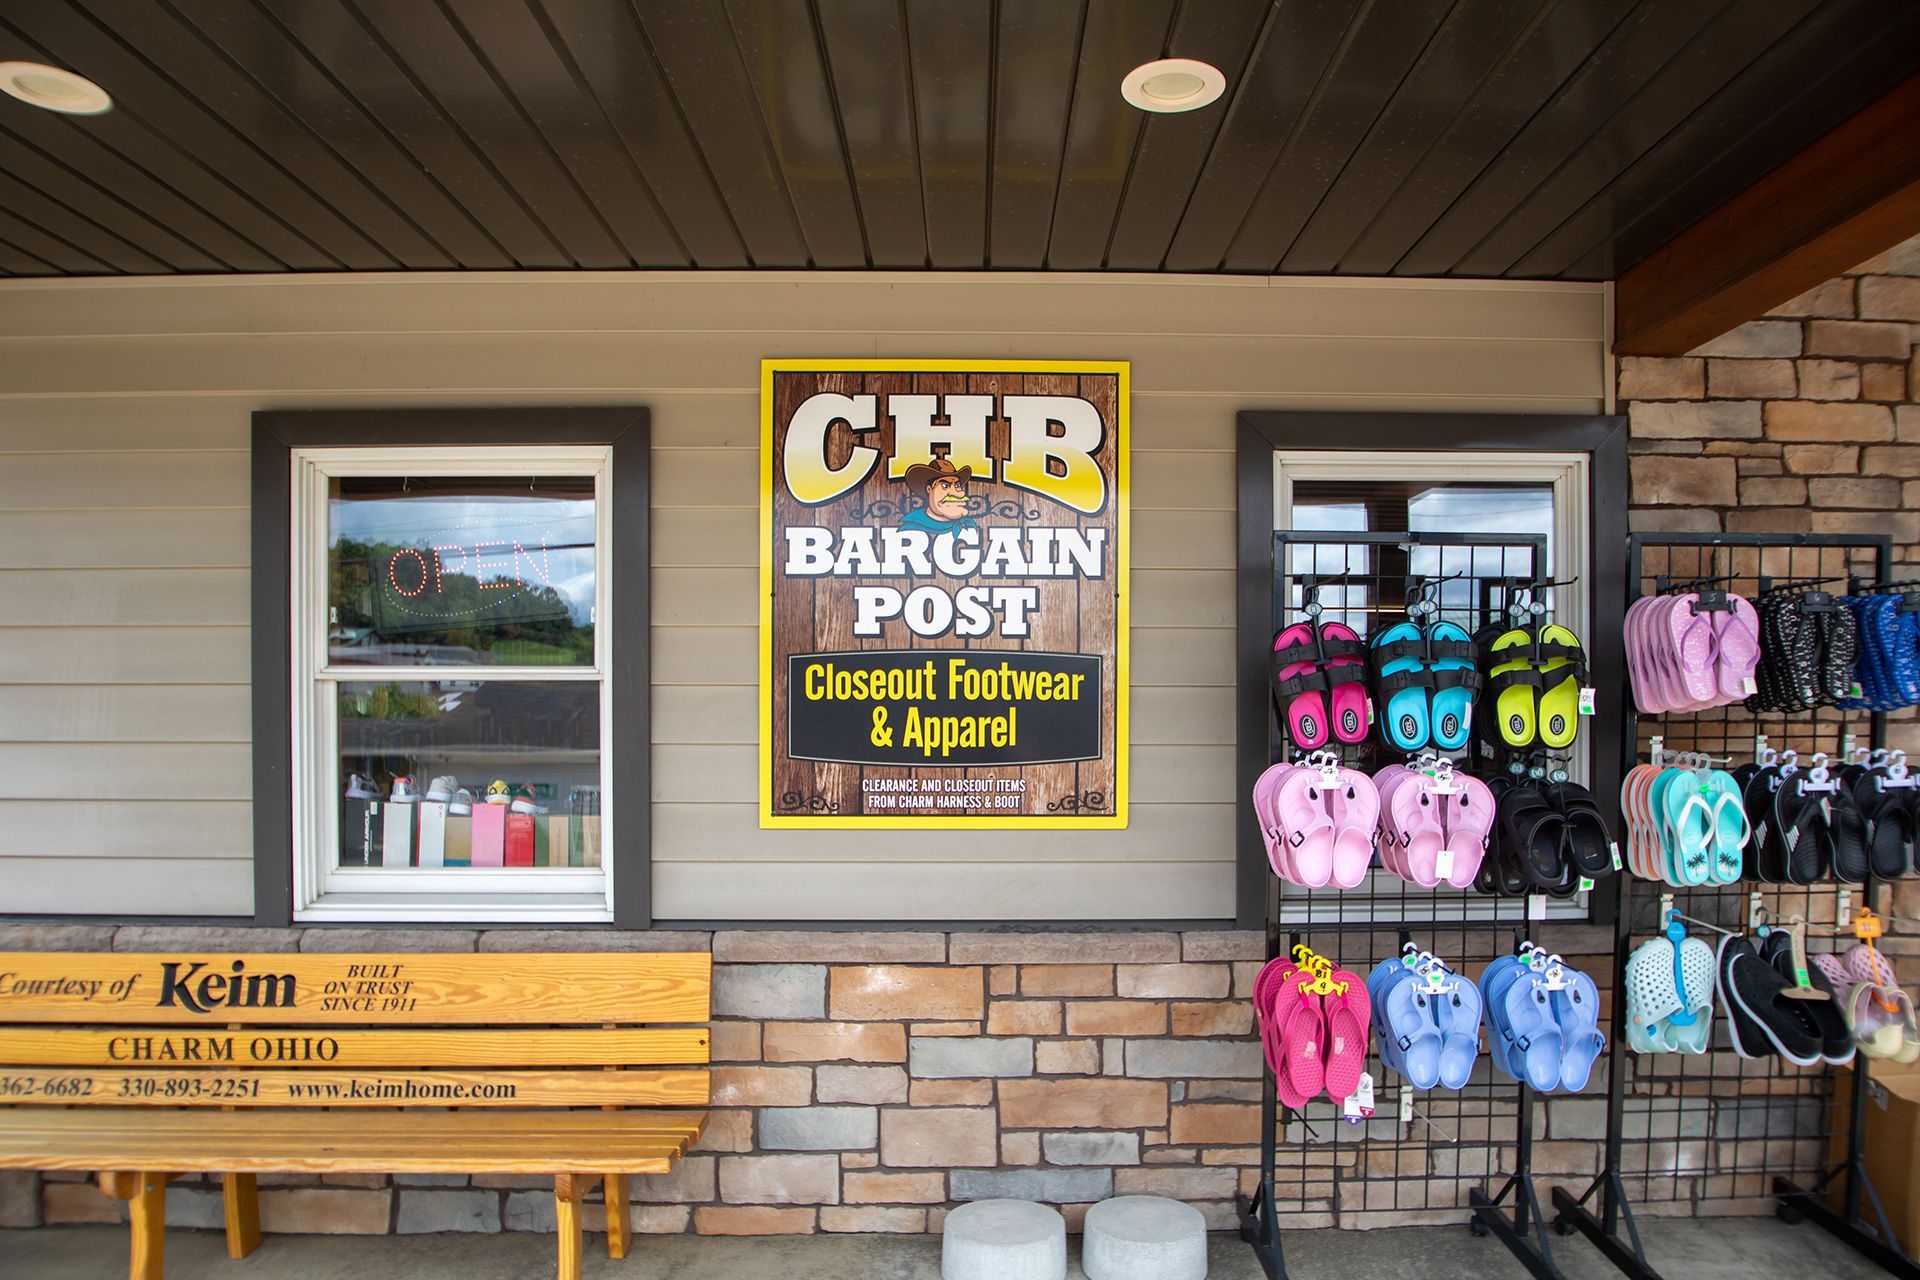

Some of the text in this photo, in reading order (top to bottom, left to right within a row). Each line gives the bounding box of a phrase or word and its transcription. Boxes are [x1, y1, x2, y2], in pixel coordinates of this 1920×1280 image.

[783, 392, 1106, 514] CHB
[390, 537, 549, 596] OPEN
[784, 526, 1105, 577] BARGAIN
[853, 585, 1037, 636] POST
[804, 659, 1085, 701] Closeout Footwear
[870, 705, 1017, 757] & Apparel
[862, 779, 1026, 792] CLEARANCE AND CLOSEOUT ITEMS
[868, 795, 1020, 808] FROM CHARM HARNESS & BOOT
[0, 960, 297, 1013] Courtesy of Keim
[324, 981, 413, 995] ON TRUST
[347, 965, 403, 978] BUILT
[320, 998, 416, 1011] SINCE 1911
[108, 1037, 339, 1061] CHARM OHIO
[0, 1076, 517, 1099] 362-6682 330-893-2251 www.keimhome.com
